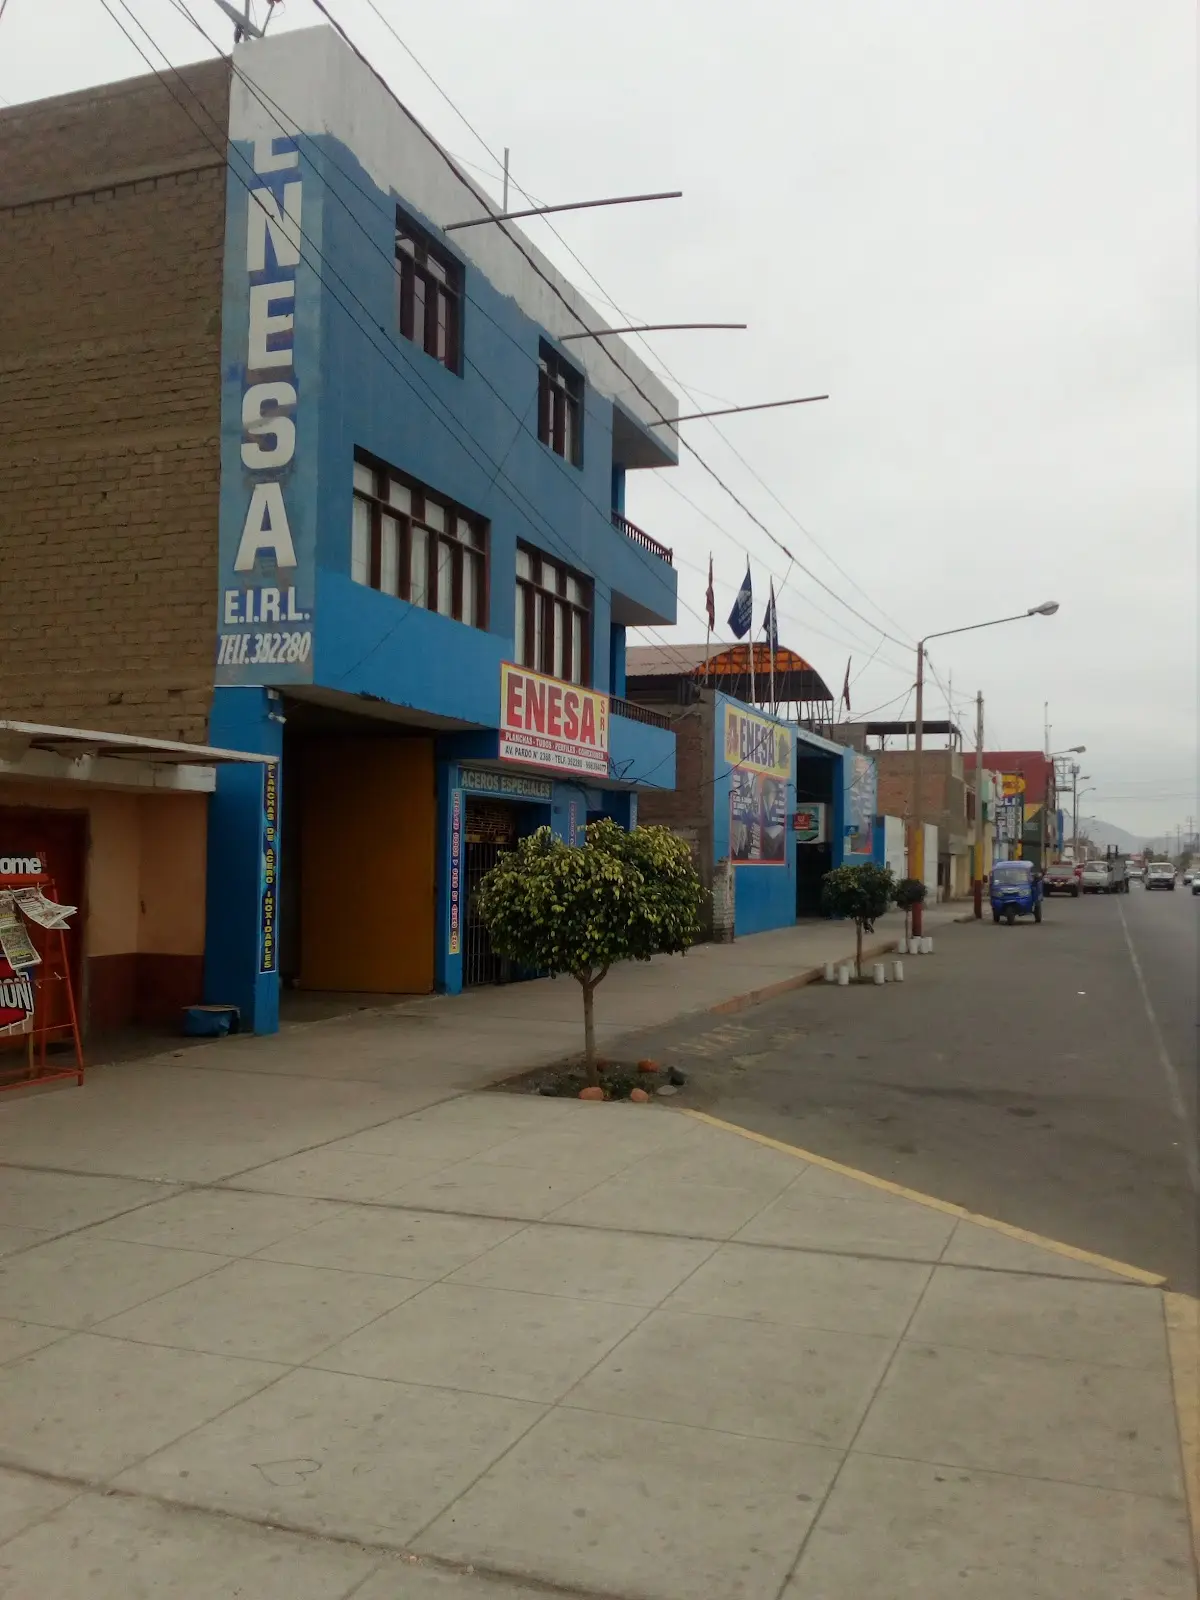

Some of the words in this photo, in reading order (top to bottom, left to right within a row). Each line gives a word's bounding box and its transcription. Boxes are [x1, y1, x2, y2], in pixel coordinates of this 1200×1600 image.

[224, 586, 311, 624] E.I.R.L.
[507, 672, 596, 745] ENESA
[505, 732, 533, 746] PLANCHAS
[514, 747, 532, 759] PARDO
[740, 717, 775, 768] ENESA
[266, 764, 276, 821] PLANCHAS
[462, 770, 499, 790] ACEROS
[501, 777, 550, 798] ESPECIALES
[266, 827, 275, 842] DE
[265, 848, 275, 884] ACERO
[264, 890, 274, 969] INOXIDABLES
